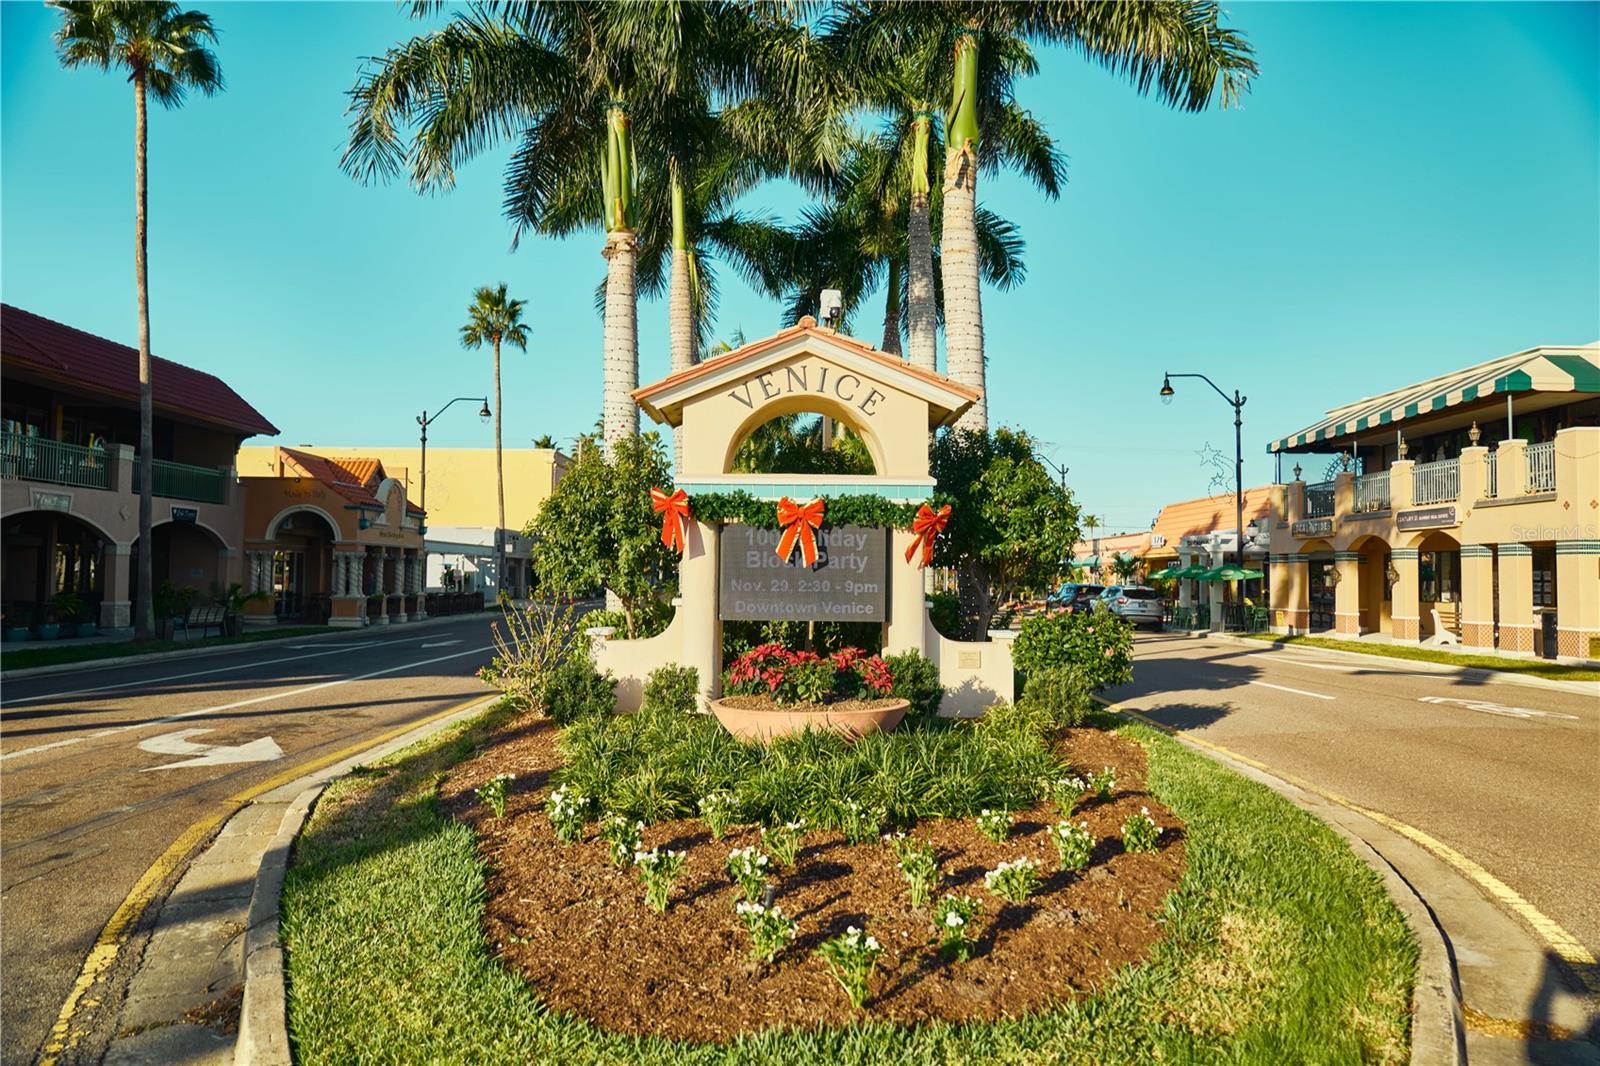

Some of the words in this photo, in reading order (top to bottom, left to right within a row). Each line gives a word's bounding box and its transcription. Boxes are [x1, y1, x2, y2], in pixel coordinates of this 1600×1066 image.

[728, 365, 886, 417] VENICE
[815, 552, 868, 573] Party
[731, 579, 766, 592] Nov.
[798, 580, 830, 593] 2:30
[845, 580, 878, 596] 9pm
[735, 600, 817, 614] Downtown
[822, 601, 874, 615] Venice
